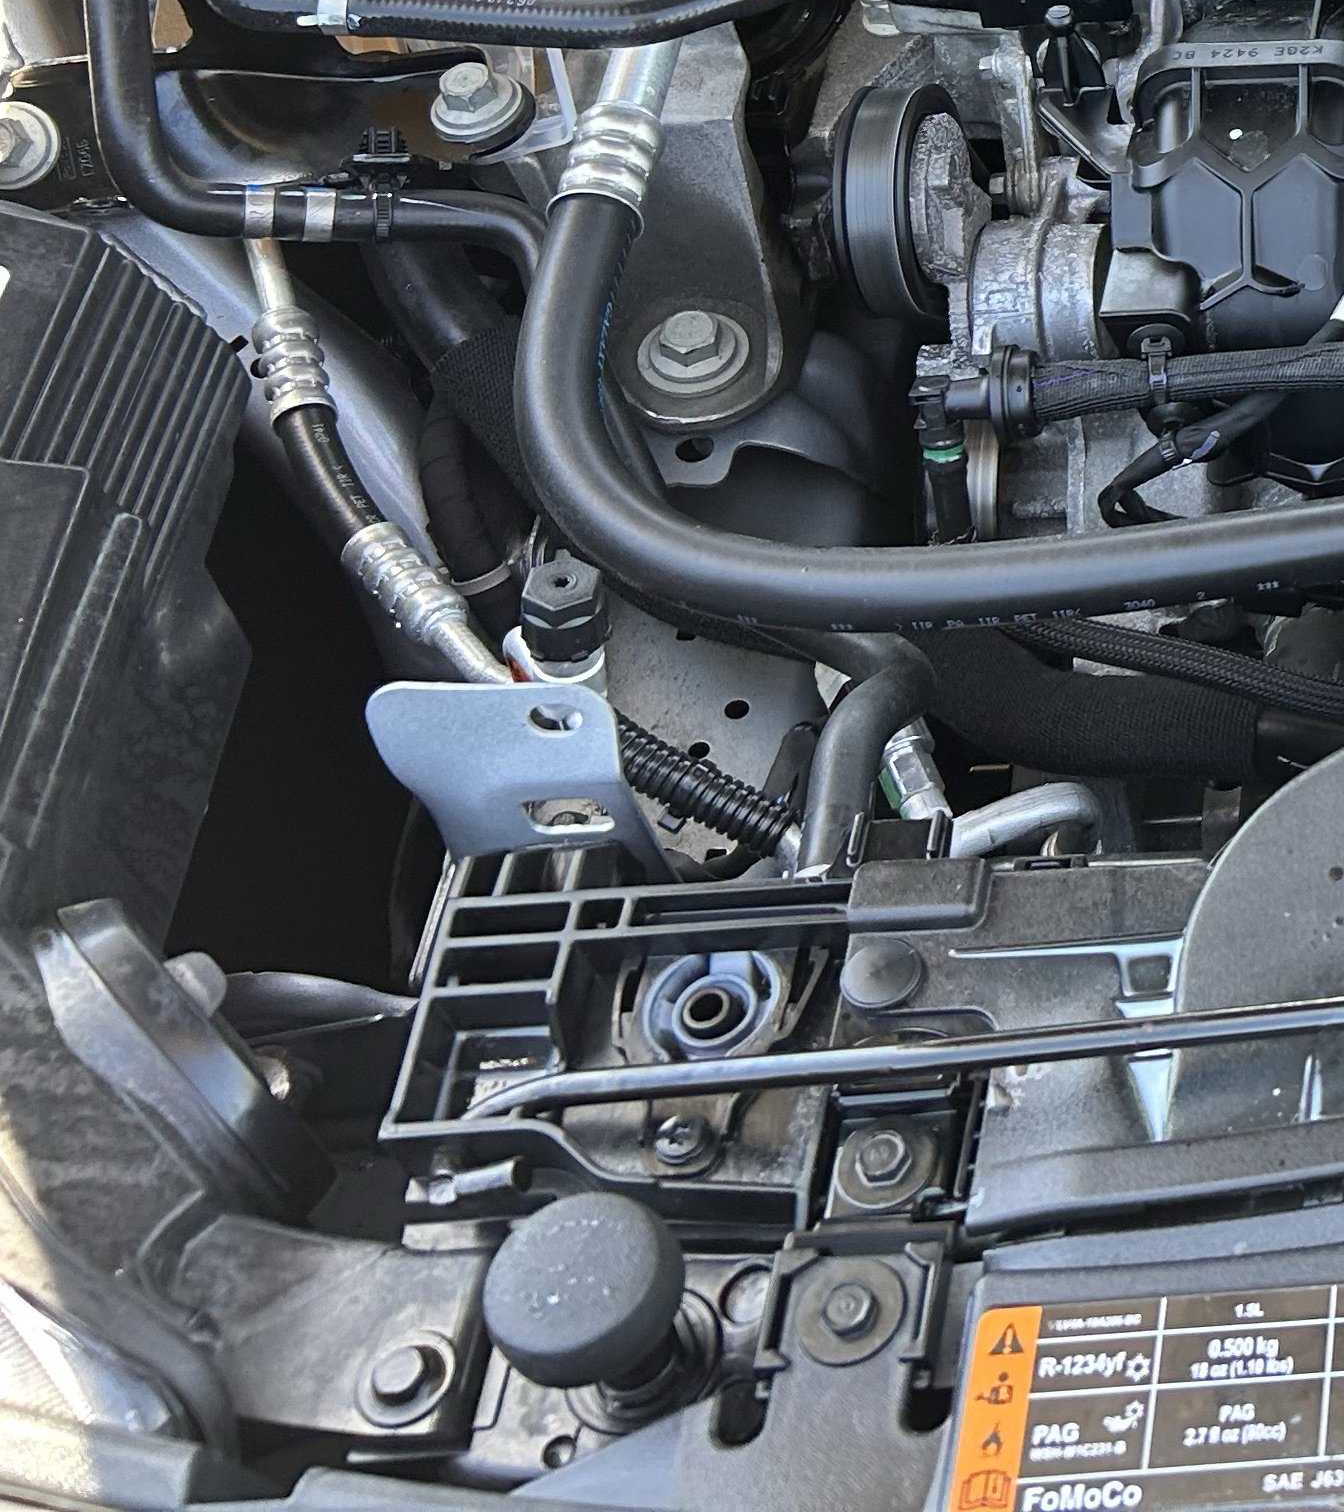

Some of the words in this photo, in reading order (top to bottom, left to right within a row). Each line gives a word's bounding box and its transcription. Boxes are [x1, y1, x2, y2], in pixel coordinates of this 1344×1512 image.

[1210, 47, 1259, 59] 9424
[1208, 1337, 1253, 1360] 0.500
[1257, 1335, 1279, 1358] kg
[1038, 1350, 1127, 1379] R-1234yf
[1219, 1403, 1255, 1424] PAG
[1031, 1421, 1080, 1446] PAG
[1262, 1472, 1304, 1493] SAE
[1022, 1480, 1143, 1512] FoMoCo
